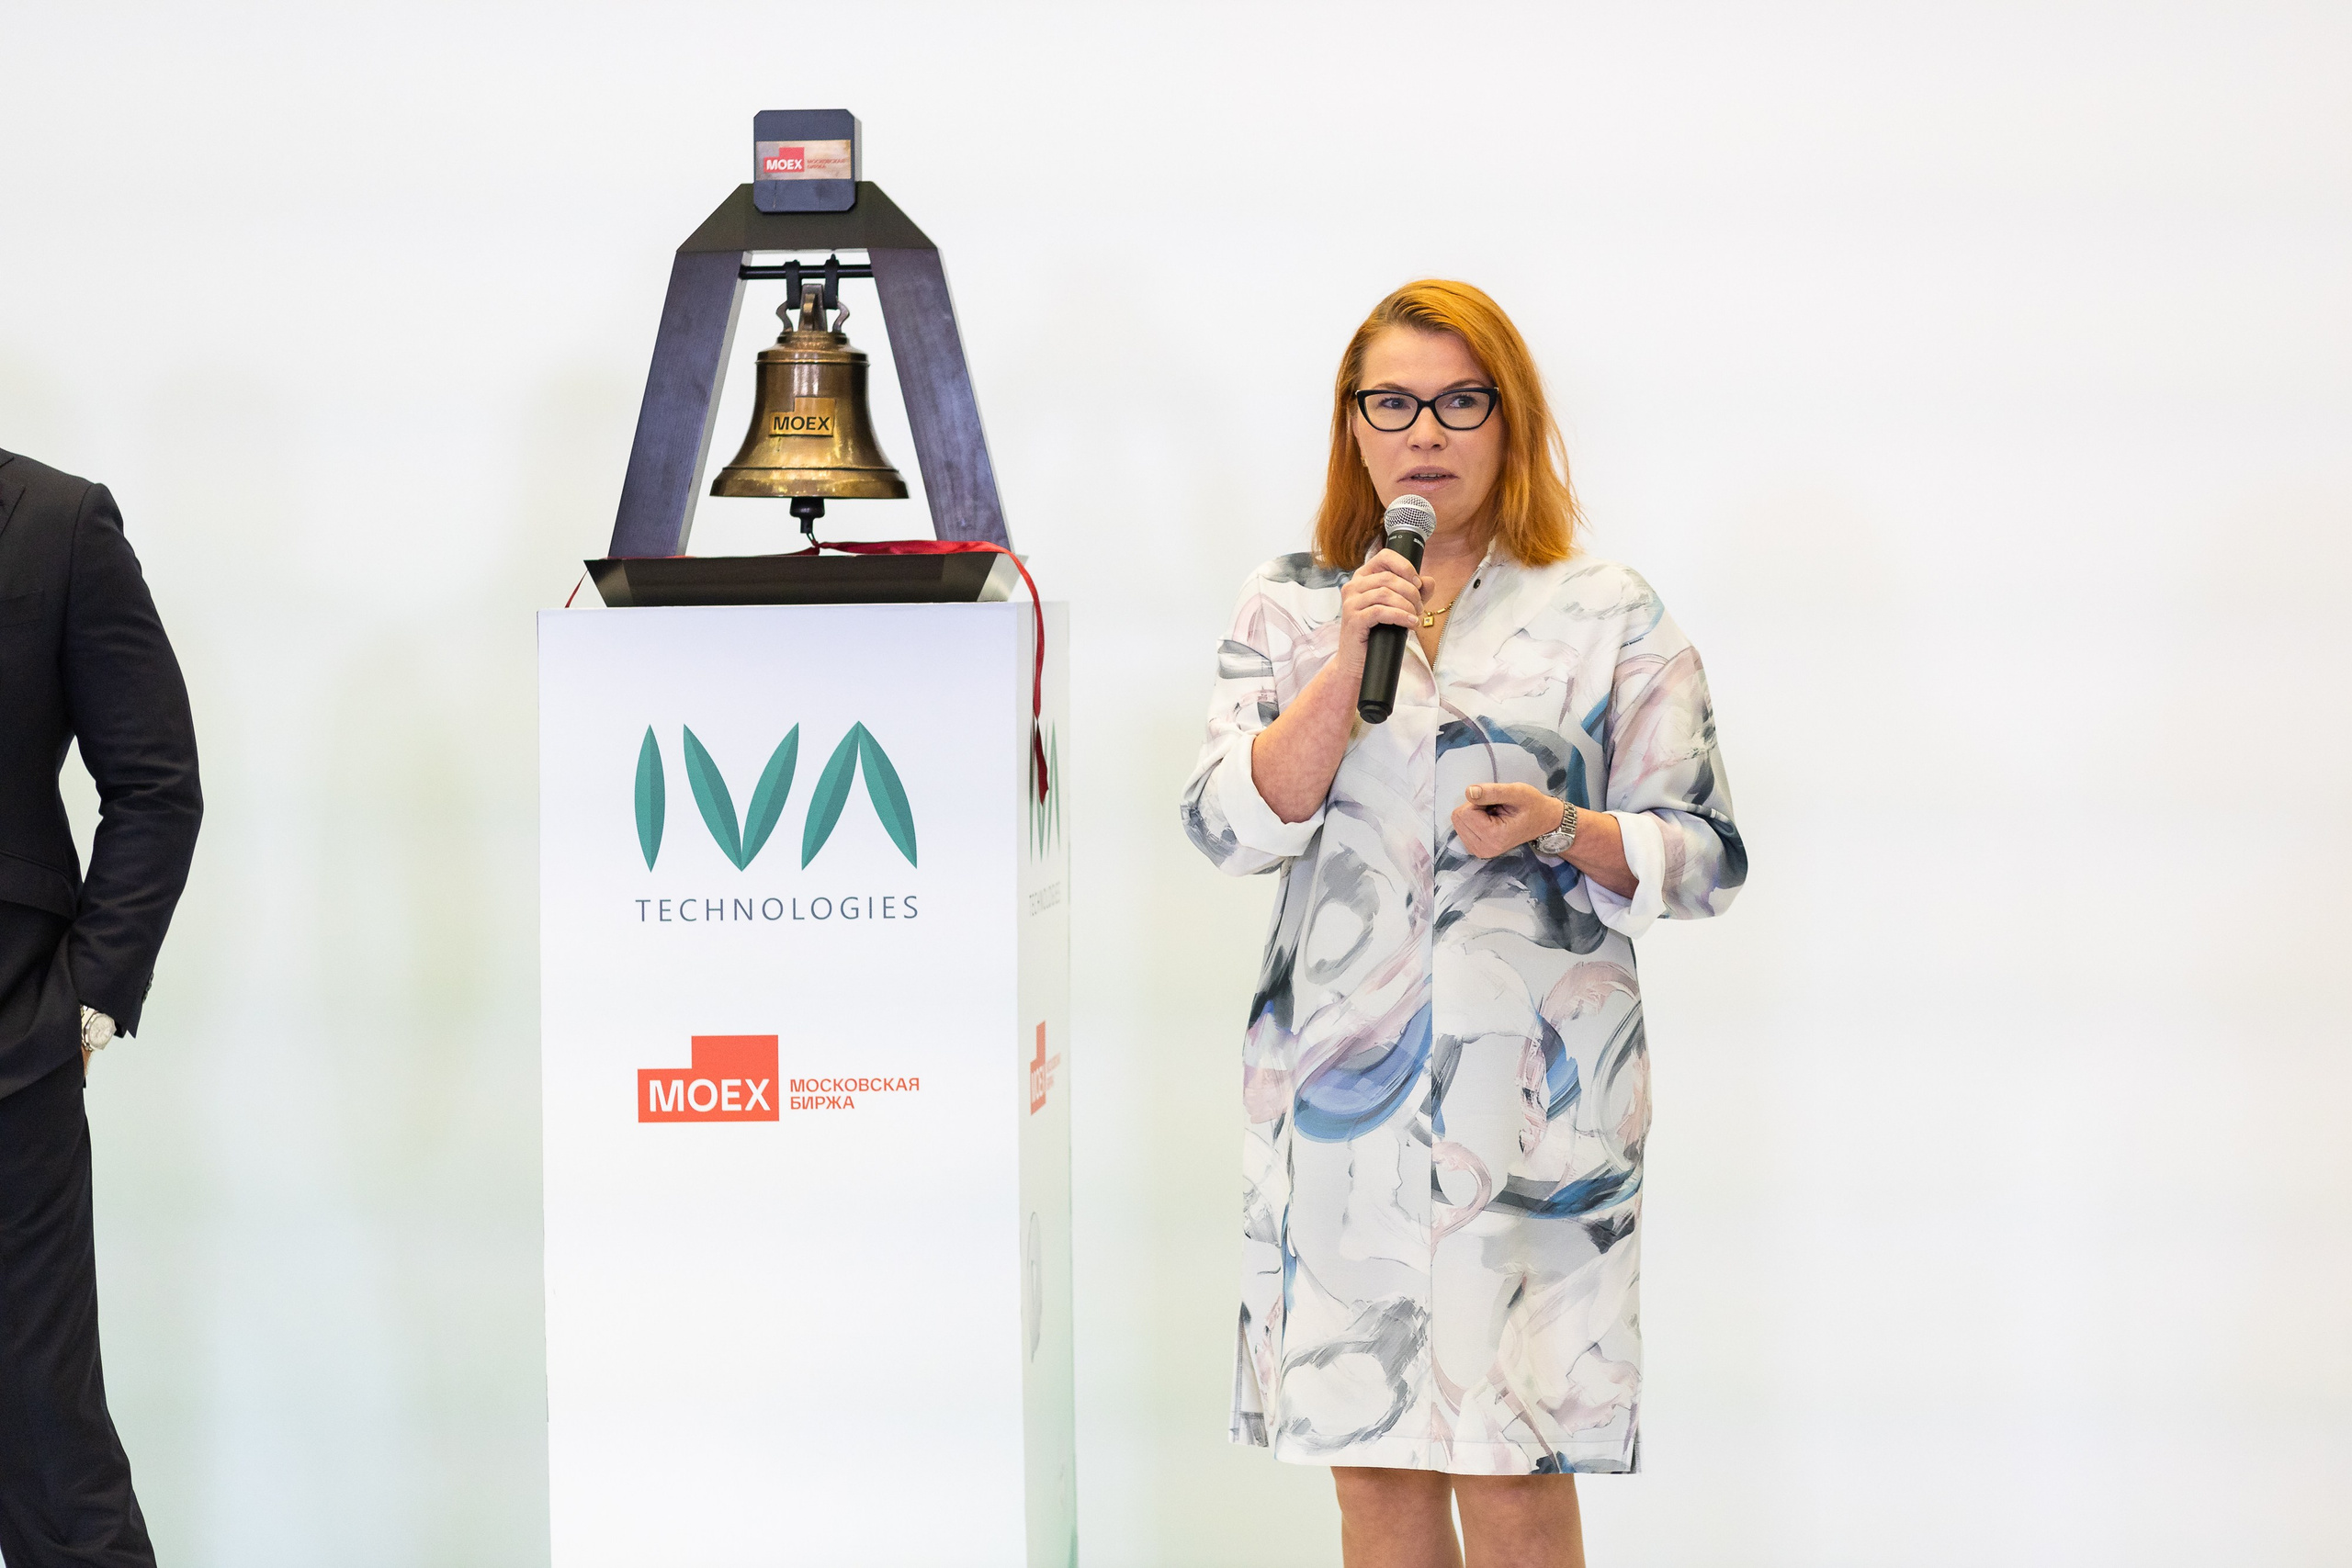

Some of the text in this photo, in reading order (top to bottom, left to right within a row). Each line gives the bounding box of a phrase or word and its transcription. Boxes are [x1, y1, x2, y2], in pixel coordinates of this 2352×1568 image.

[766, 159, 802, 170] MOEX
[773, 416, 831, 431] MOEX
[634, 720, 918, 873] IVA
[635, 896, 919, 922] TECHNOLOGIES
[789, 1077, 920, 1093] МОСКОВСКАЯ
[649, 1078, 771, 1112] MOEX
[790, 1096, 855, 1110] БИРЖА
